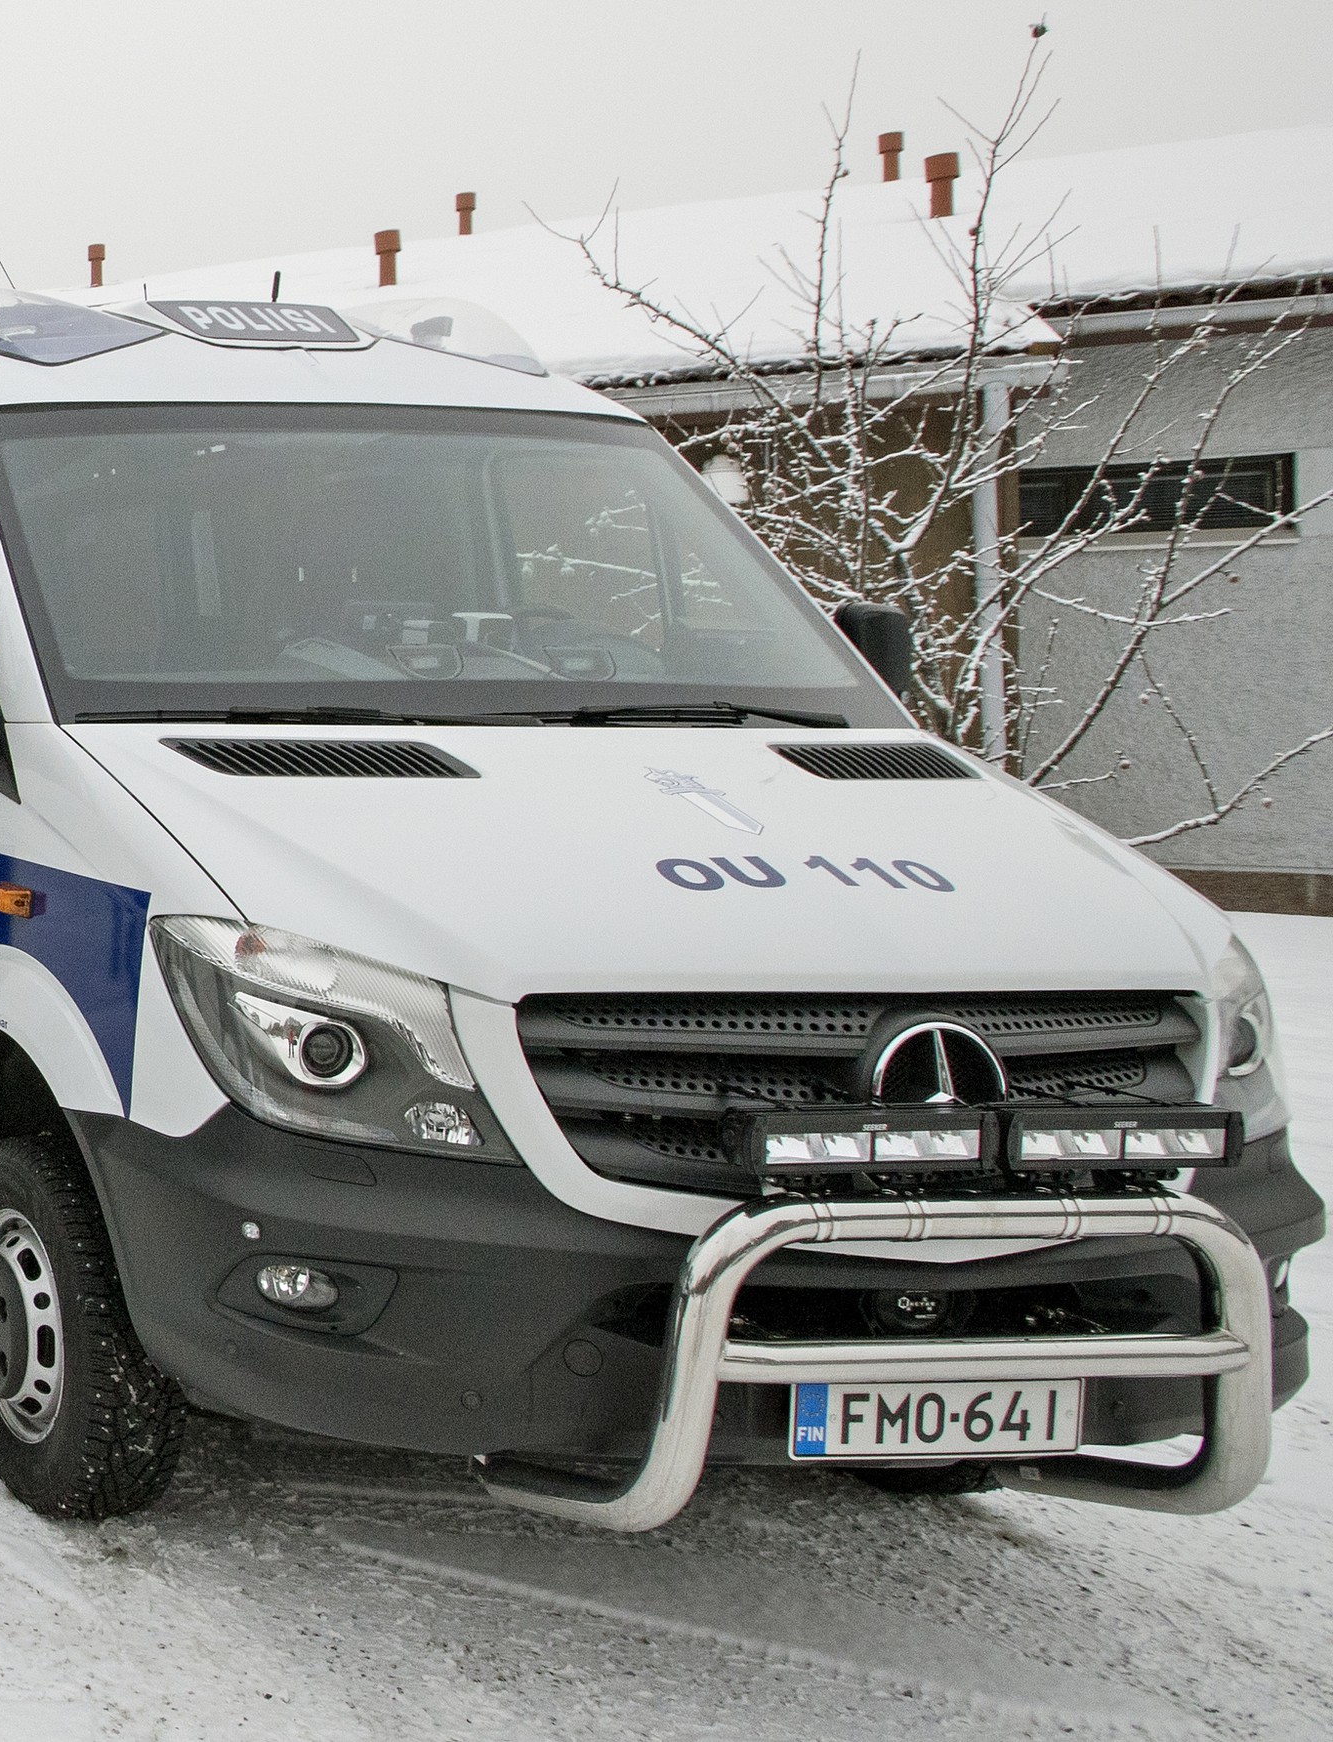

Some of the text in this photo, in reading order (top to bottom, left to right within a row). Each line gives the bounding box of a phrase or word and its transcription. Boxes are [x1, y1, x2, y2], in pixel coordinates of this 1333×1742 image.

[179, 306, 337, 334] POLIISI
[655, 855, 956, 893] OU 110
[861, 1123, 889, 1132] SEEKER
[1113, 1120, 1139, 1129] SEEKER
[840, 1390, 1058, 1445] FMO-641
[797, 1426, 825, 1442] FIN
